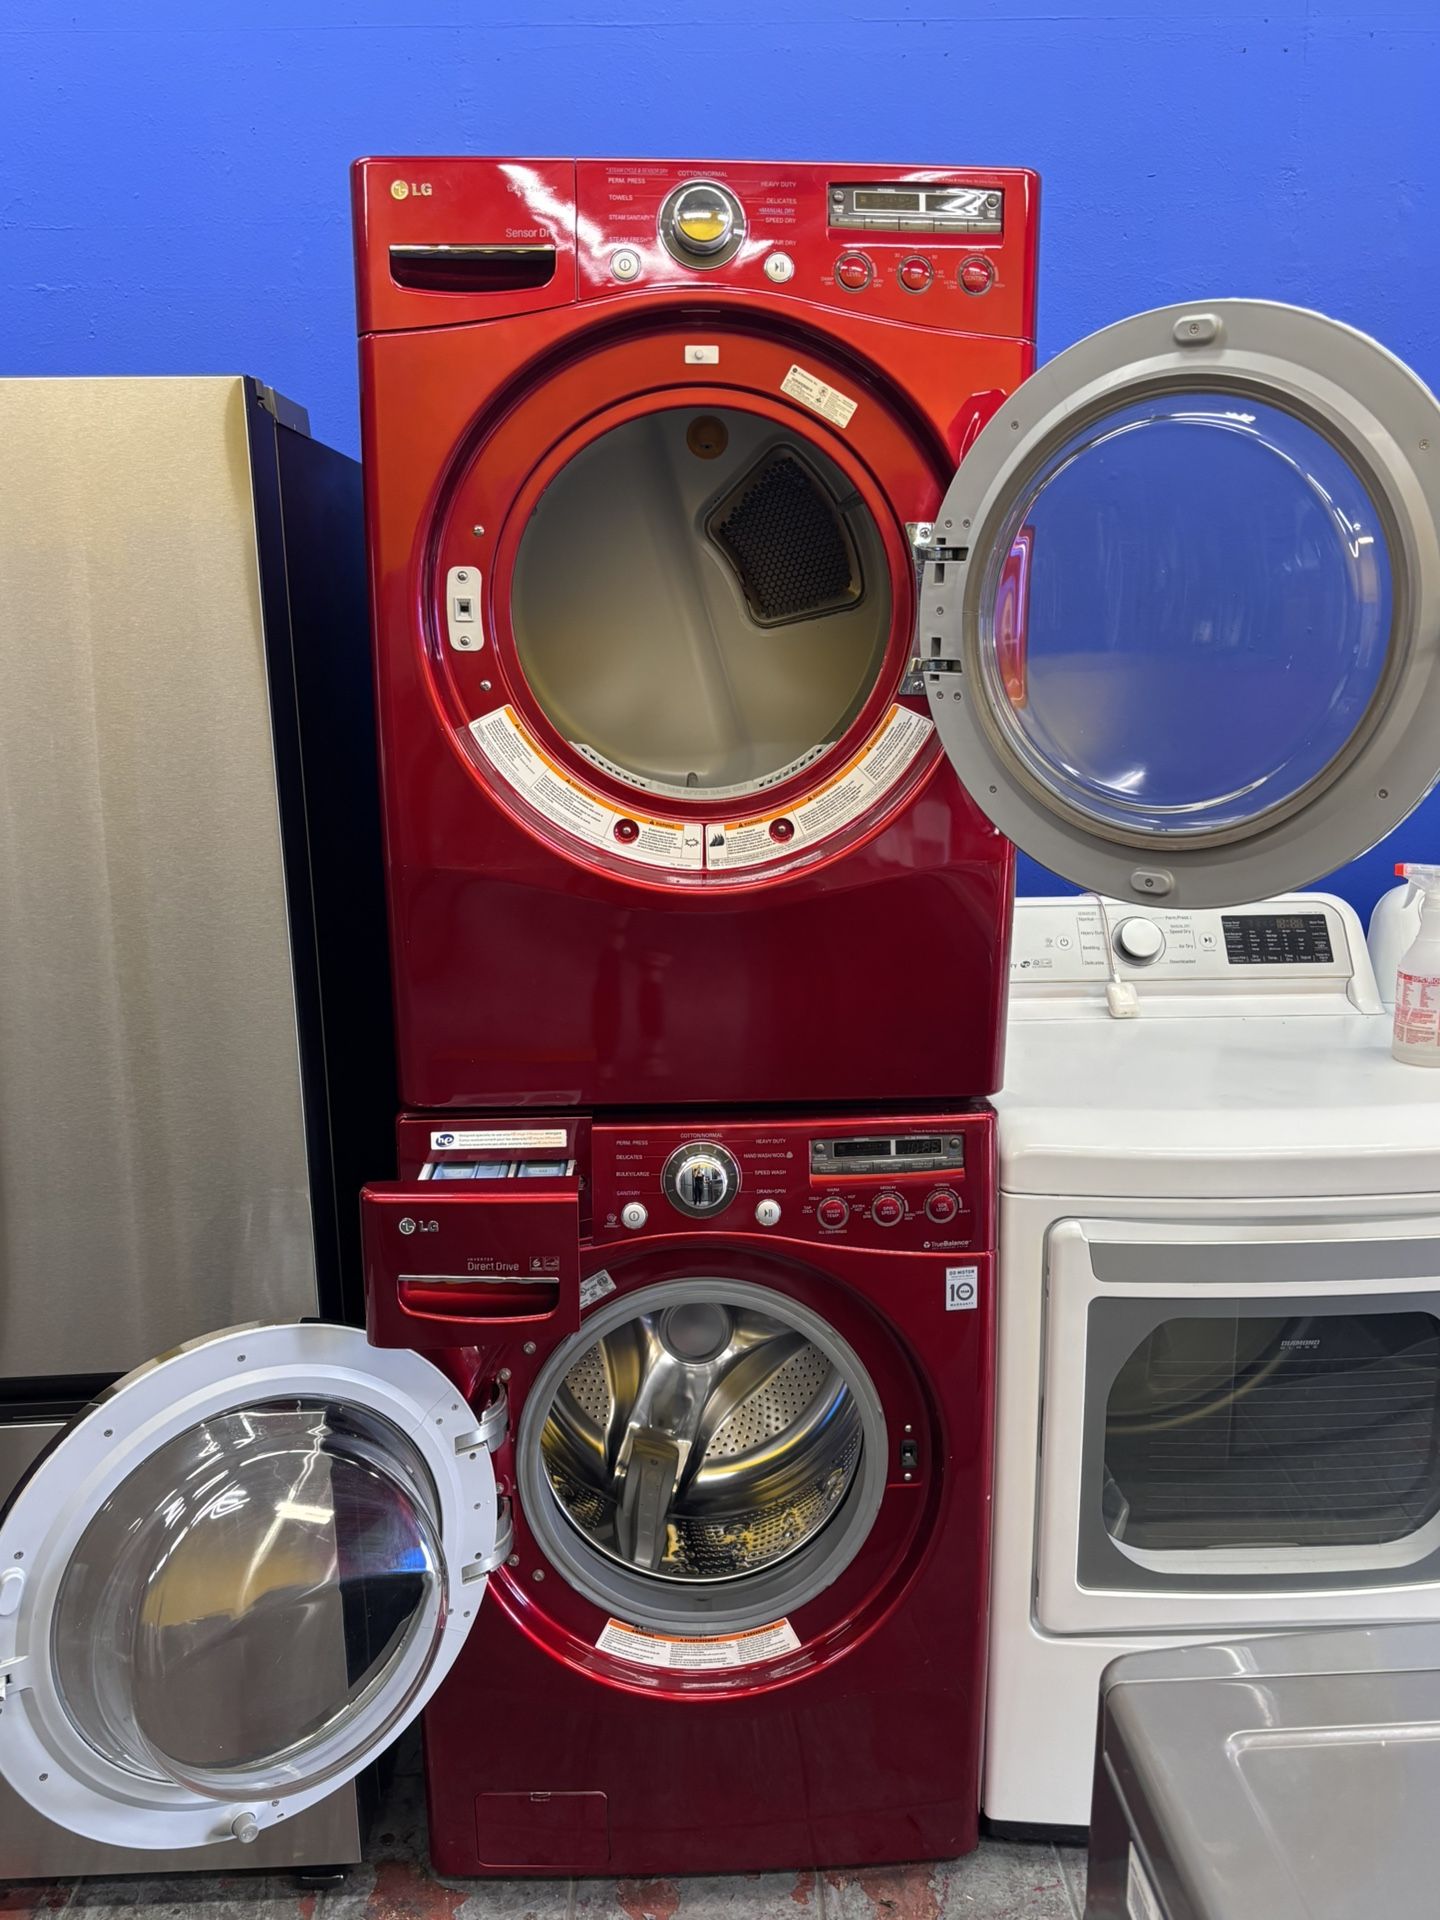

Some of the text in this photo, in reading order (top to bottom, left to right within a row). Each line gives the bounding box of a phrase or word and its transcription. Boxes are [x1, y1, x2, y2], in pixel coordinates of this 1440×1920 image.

[412, 183, 432, 196] LG
[506, 228, 537, 238] Sensor
[419, 1220, 439, 1232] LG
[467, 1261, 520, 1271] Direct Drive
[950, 1282, 974, 1302] 10
